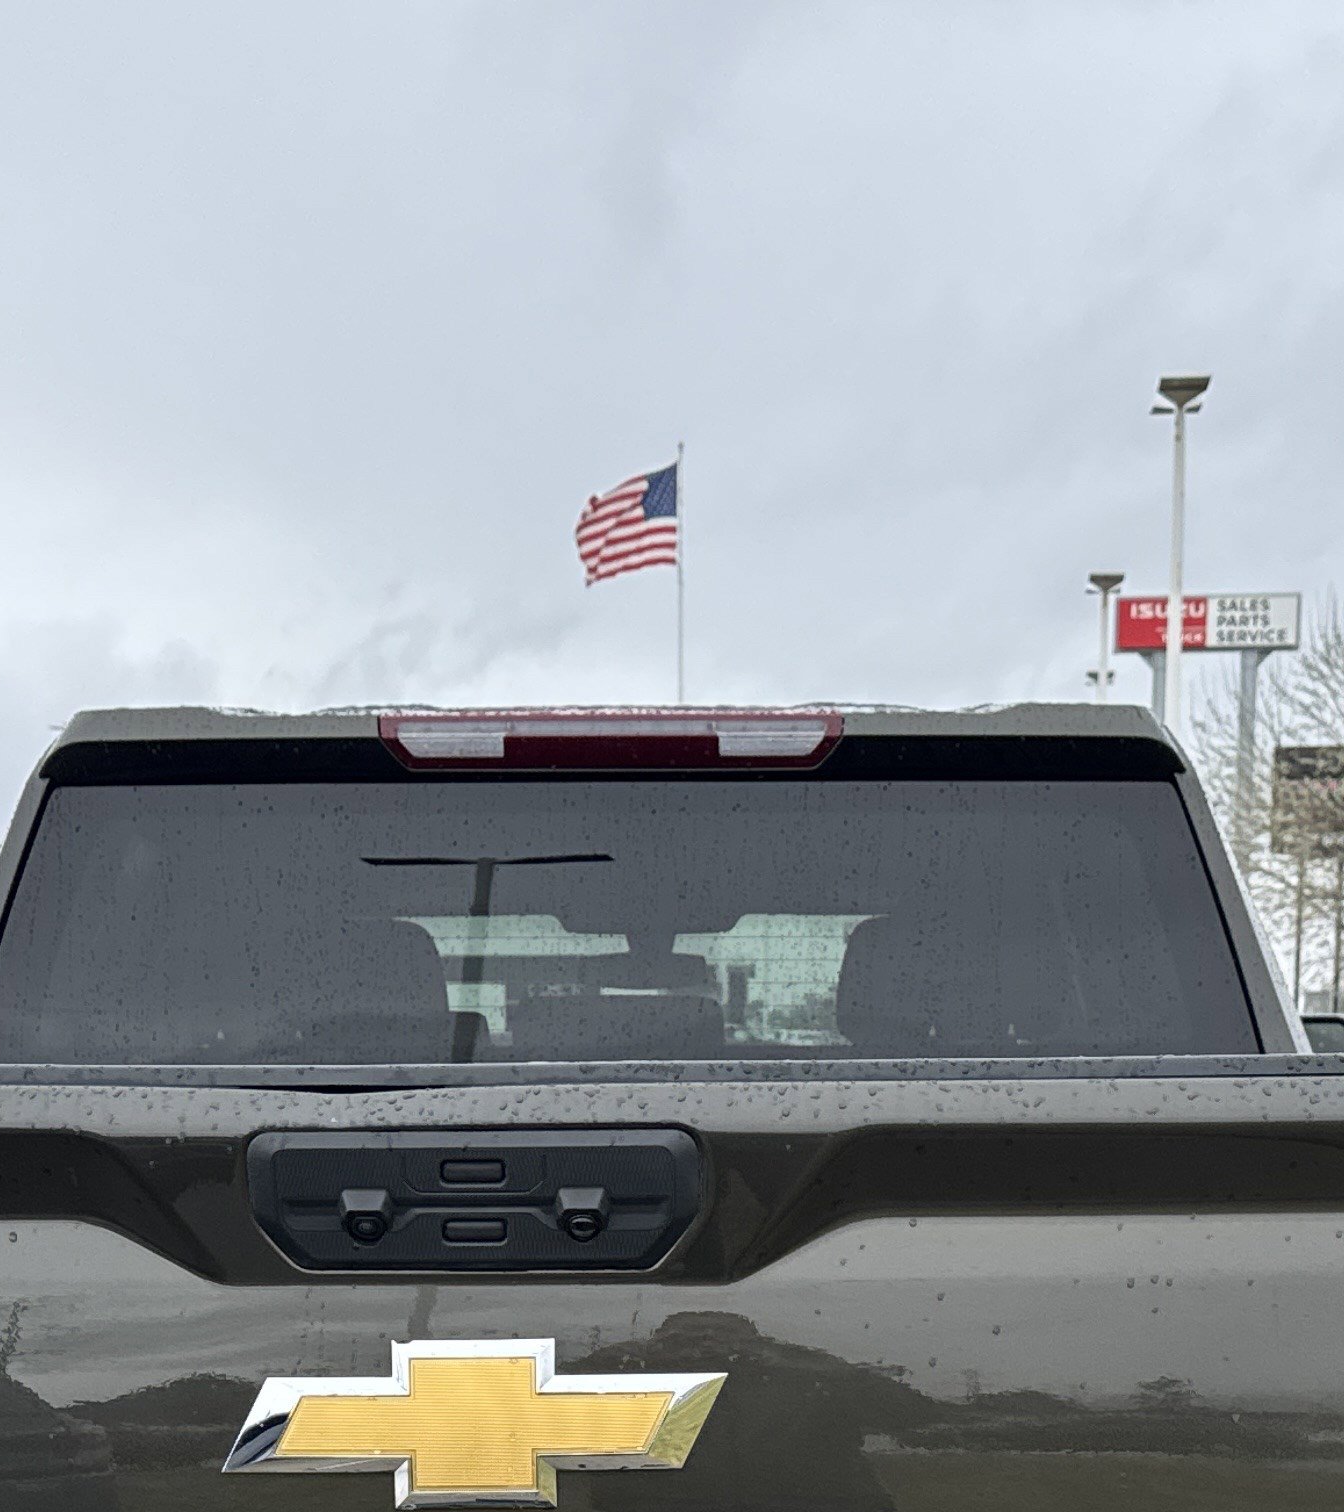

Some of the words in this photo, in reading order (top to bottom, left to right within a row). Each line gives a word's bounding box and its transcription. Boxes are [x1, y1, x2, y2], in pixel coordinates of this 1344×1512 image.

[1130, 602, 1205, 619] ISUU
[1217, 599, 1271, 612] SALES
[1217, 614, 1271, 627] PARTS
[1216, 629, 1287, 642] SERVICE
